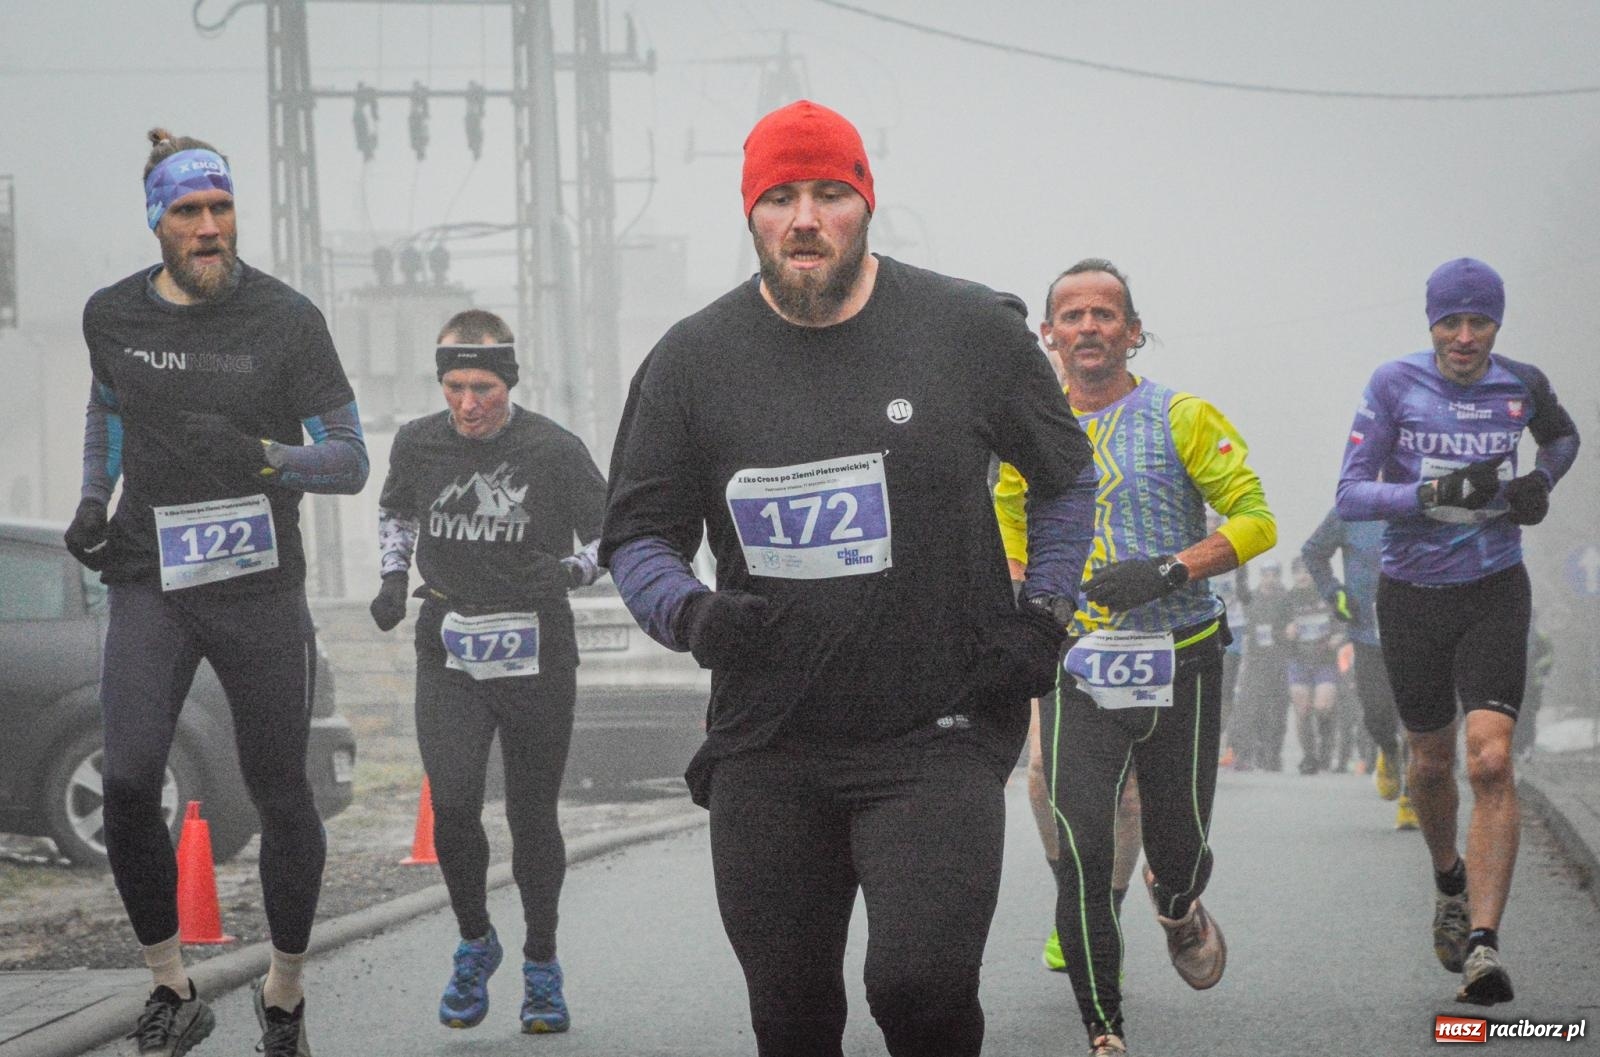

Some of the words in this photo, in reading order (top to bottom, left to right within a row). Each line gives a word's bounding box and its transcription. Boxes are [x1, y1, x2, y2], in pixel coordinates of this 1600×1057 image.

[757, 476, 779, 484] Cross
[780, 475, 791, 484] po
[792, 469, 815, 480] Ziemi
[816, 460, 870, 477] Pietrowickiej
[760, 492, 863, 544] 172
[181, 521, 255, 561] 122
[459, 632, 521, 660] 179
[1085, 653, 1154, 684] 165
